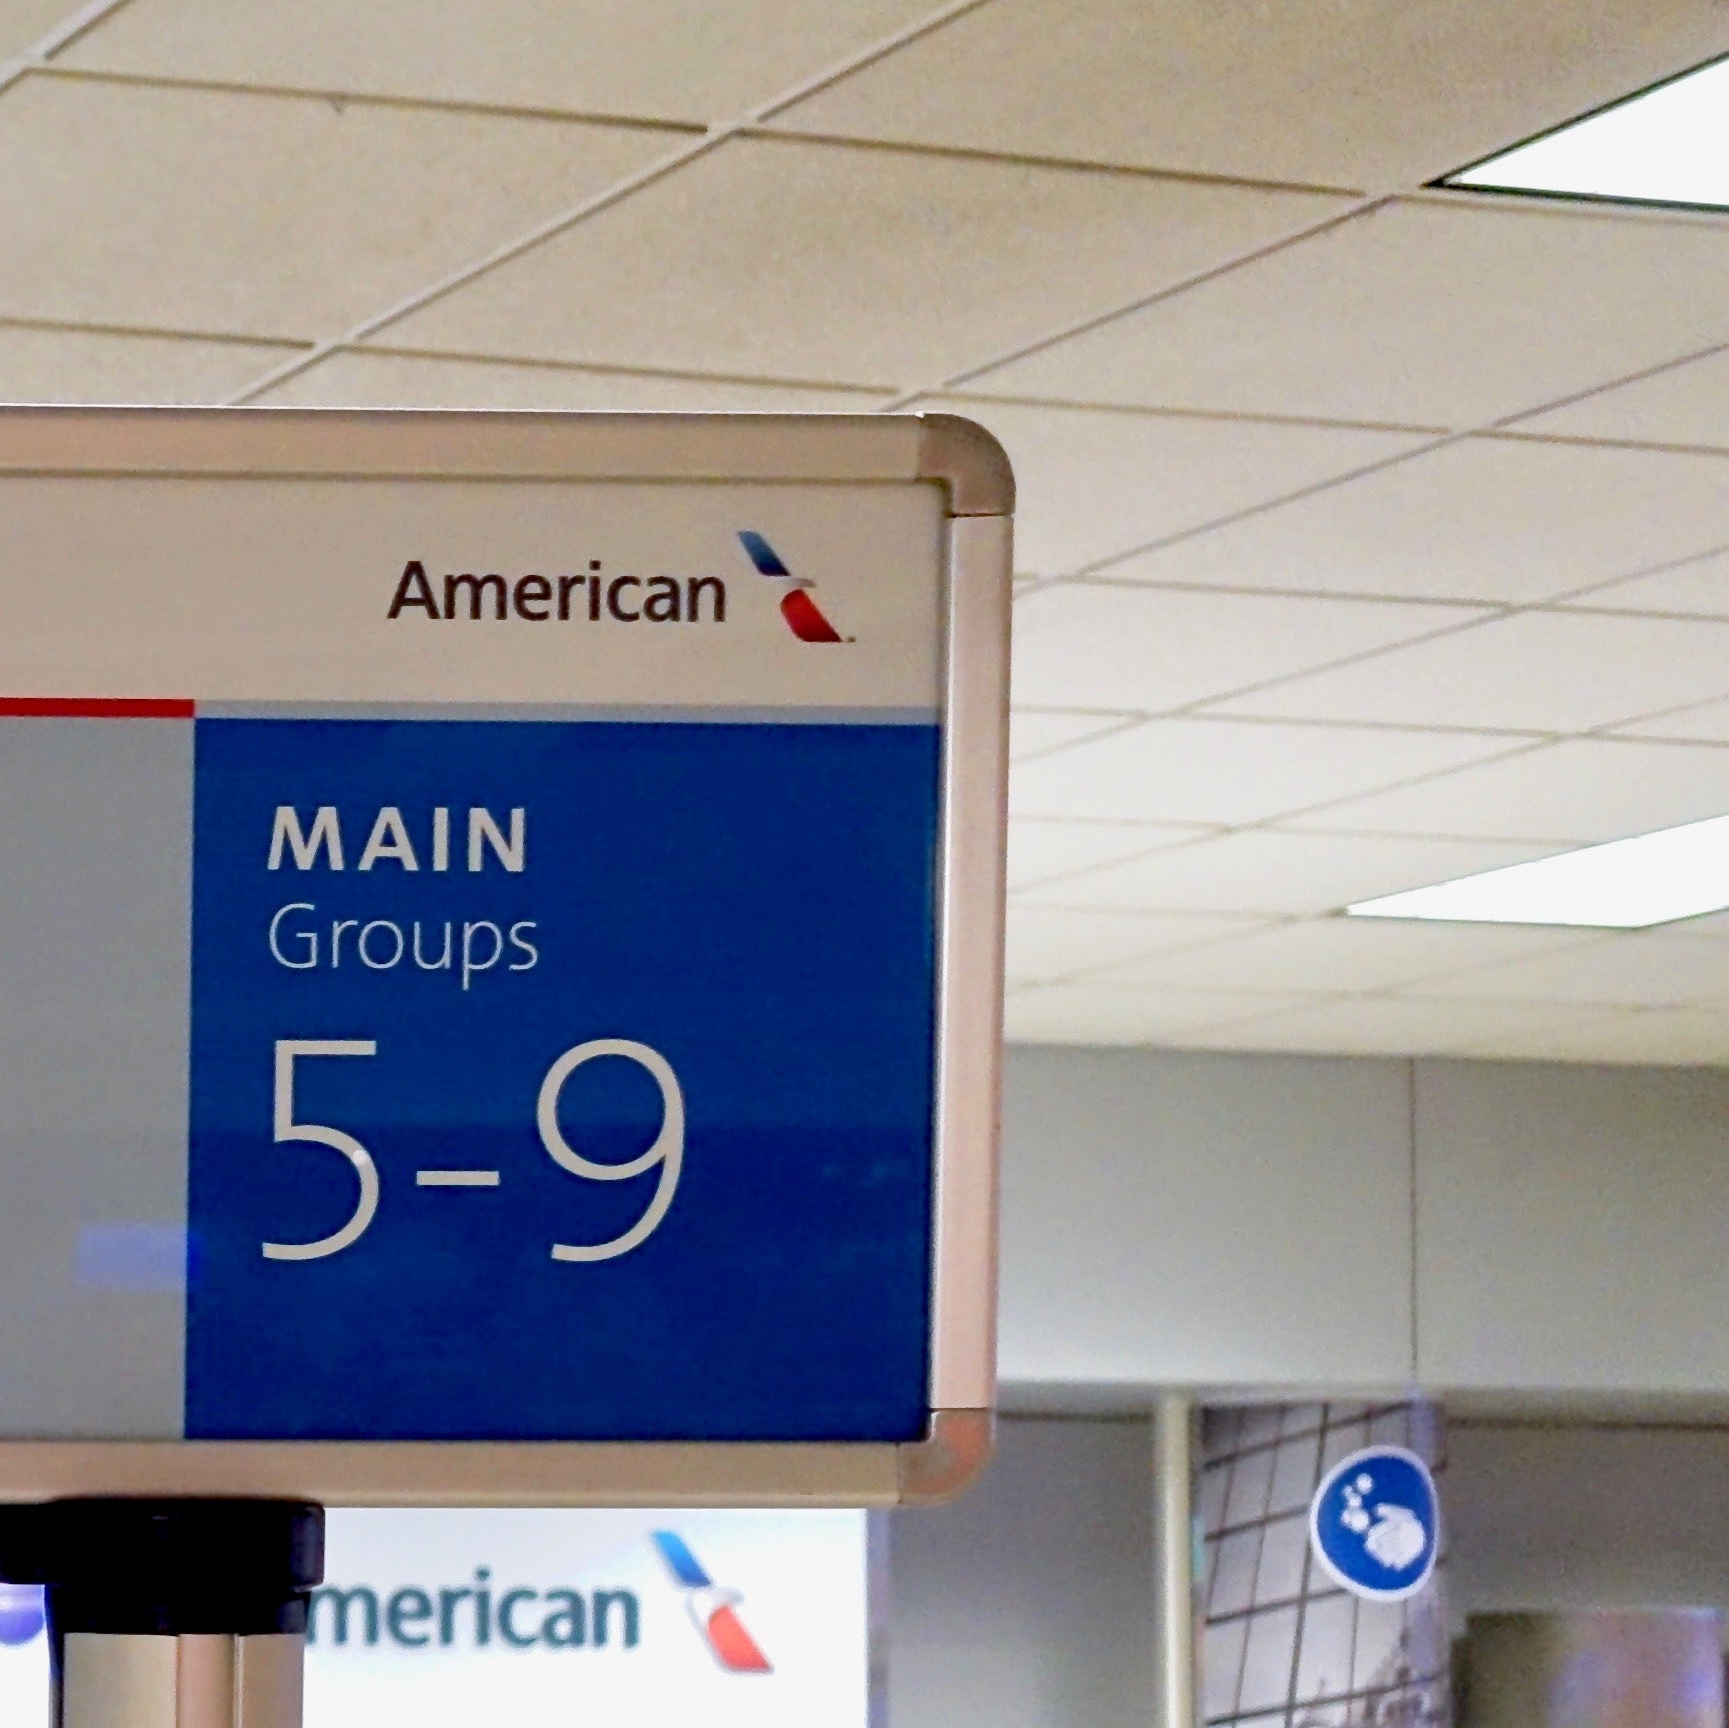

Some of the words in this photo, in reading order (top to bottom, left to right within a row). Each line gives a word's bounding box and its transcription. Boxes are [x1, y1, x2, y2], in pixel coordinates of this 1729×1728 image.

[387, 559, 726, 623] American
[267, 805, 527, 872] MAIN
[268, 902, 542, 990] Groups
[303, 1564, 642, 1647] merican
